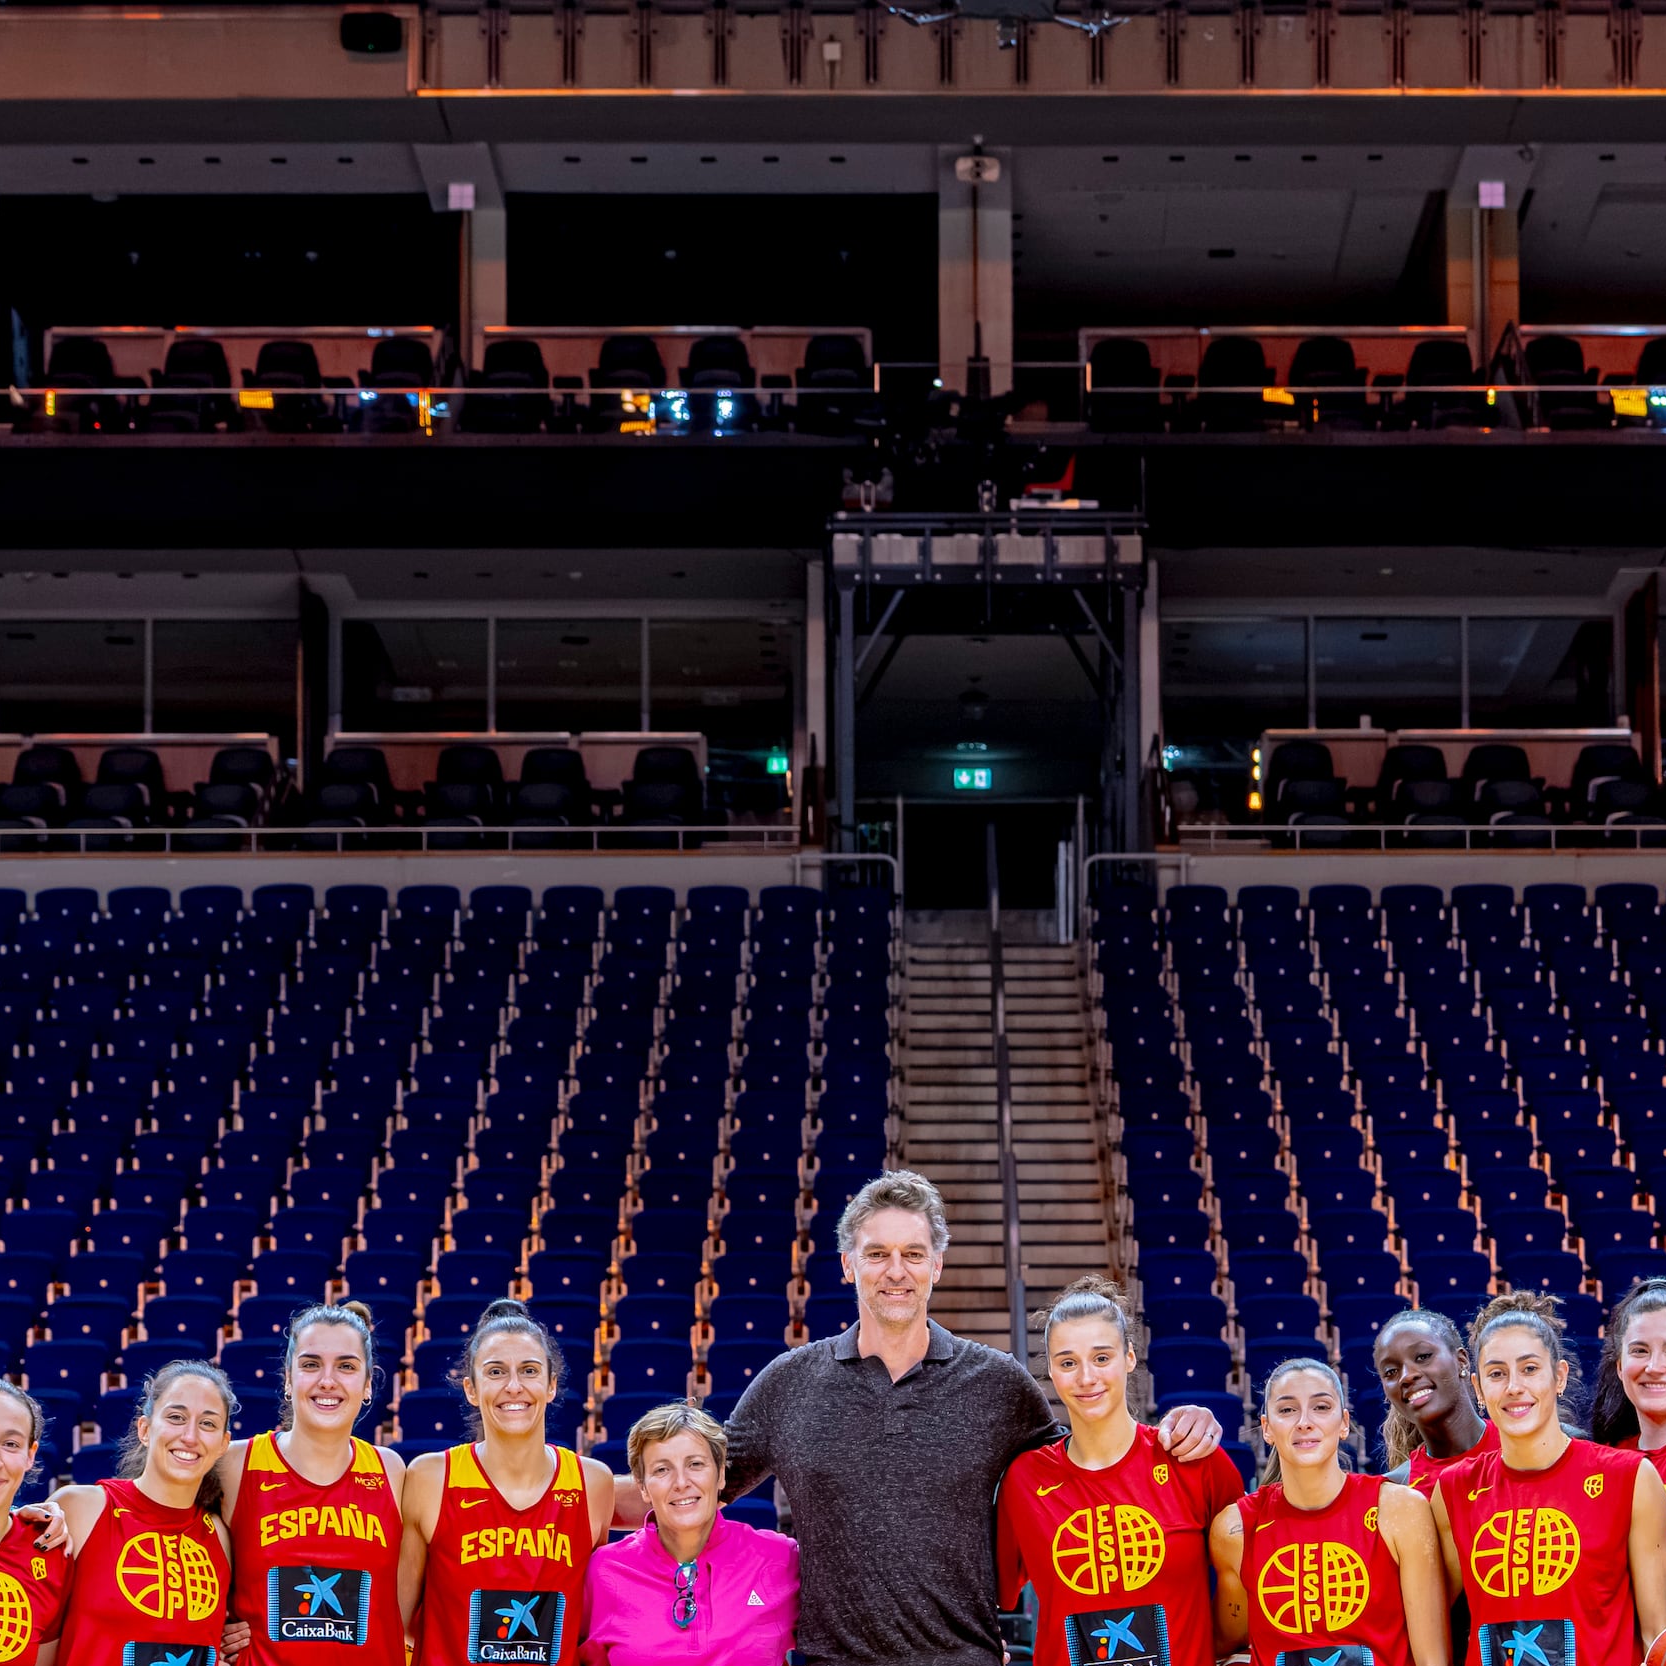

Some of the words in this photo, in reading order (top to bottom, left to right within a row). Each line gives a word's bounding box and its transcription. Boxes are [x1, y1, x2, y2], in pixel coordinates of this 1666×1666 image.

[355, 1476, 377, 1487] MGS
[260, 1503, 387, 1548] ESPAÑA
[461, 1523, 573, 1567] ESPAÑA
[282, 1621, 354, 1641] CaixaBank
[480, 1645, 547, 1662] CaixaBank
